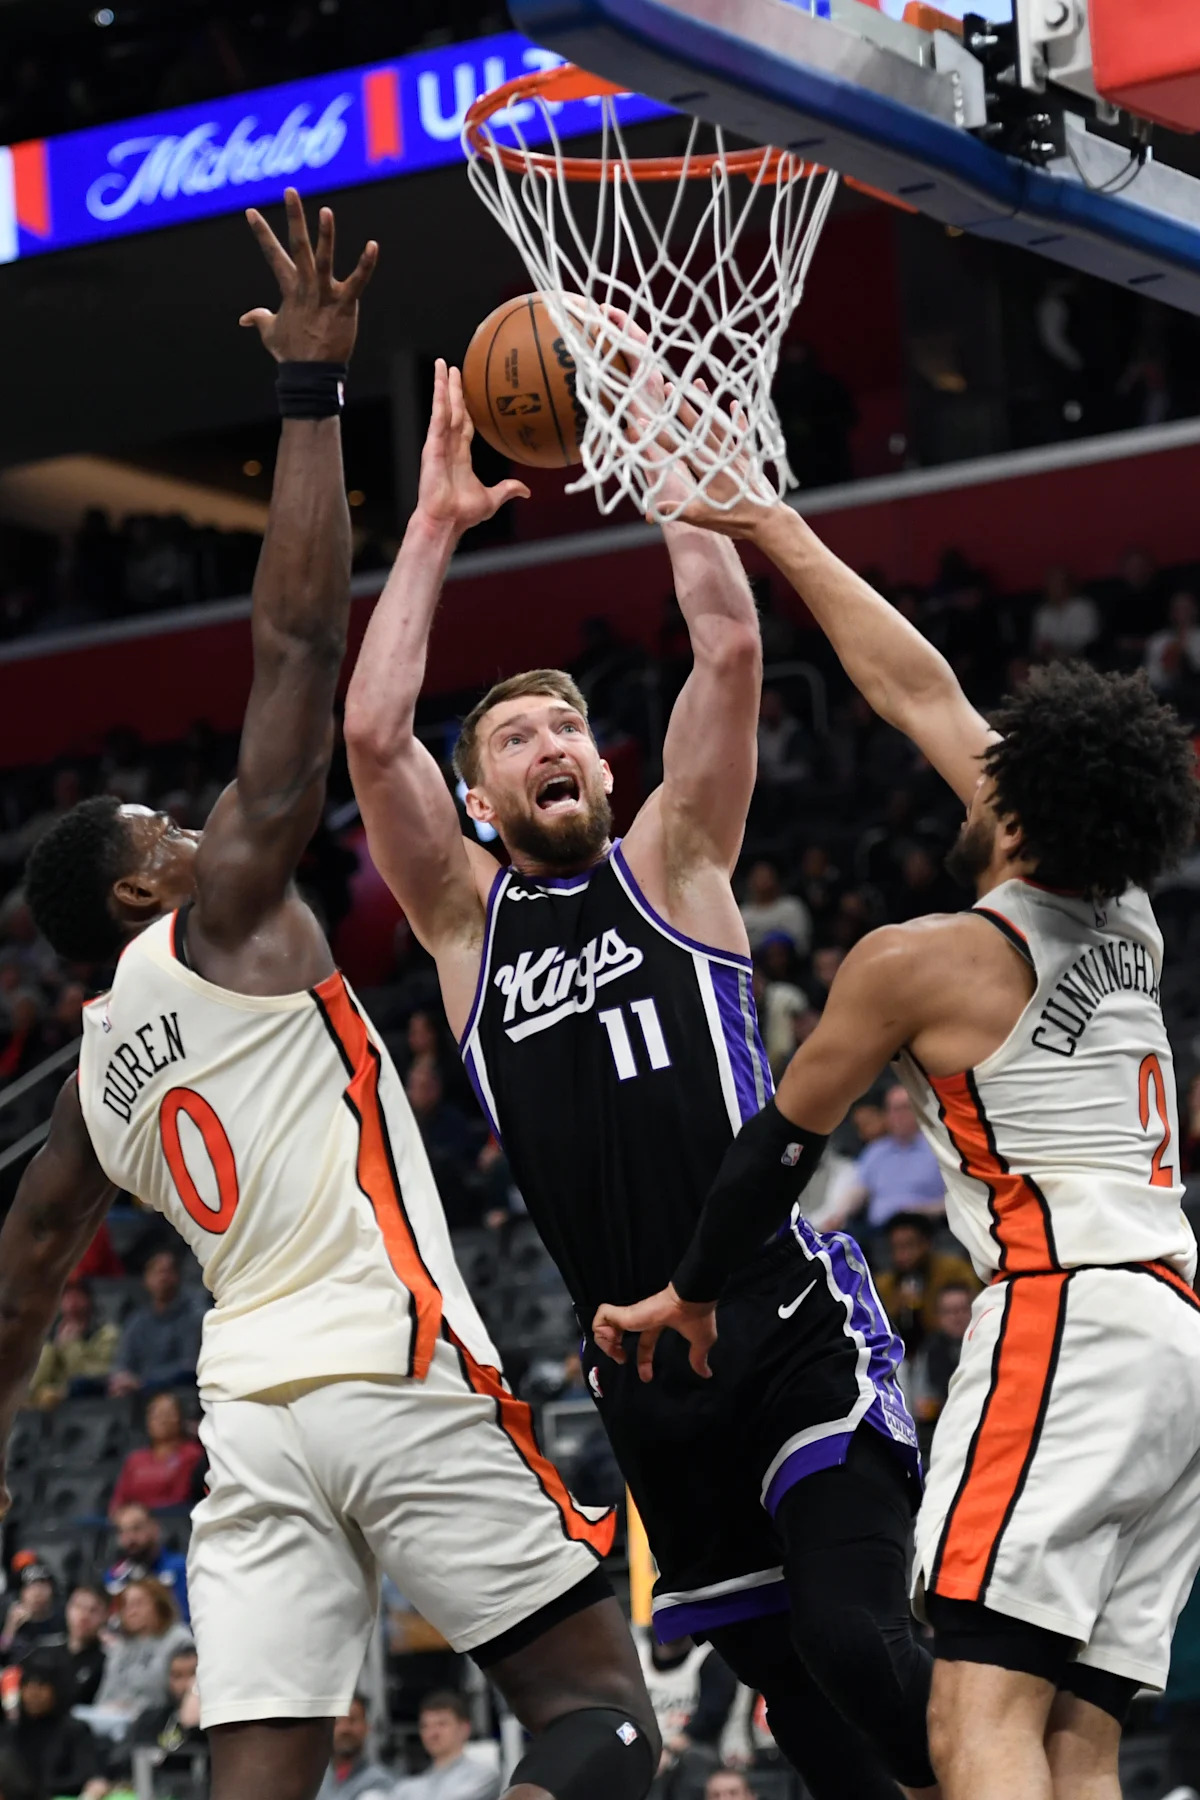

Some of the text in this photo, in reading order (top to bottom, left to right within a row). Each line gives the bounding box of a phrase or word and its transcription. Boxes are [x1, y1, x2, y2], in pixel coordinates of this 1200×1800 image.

[86, 93, 354, 221] Michelob
[494, 926, 644, 1043] Kings
[598, 997, 672, 1081] 11
[102, 1011, 187, 1125] DUREN
[1138, 1052, 1173, 1188] 2
[159, 1086, 239, 1235] 0
